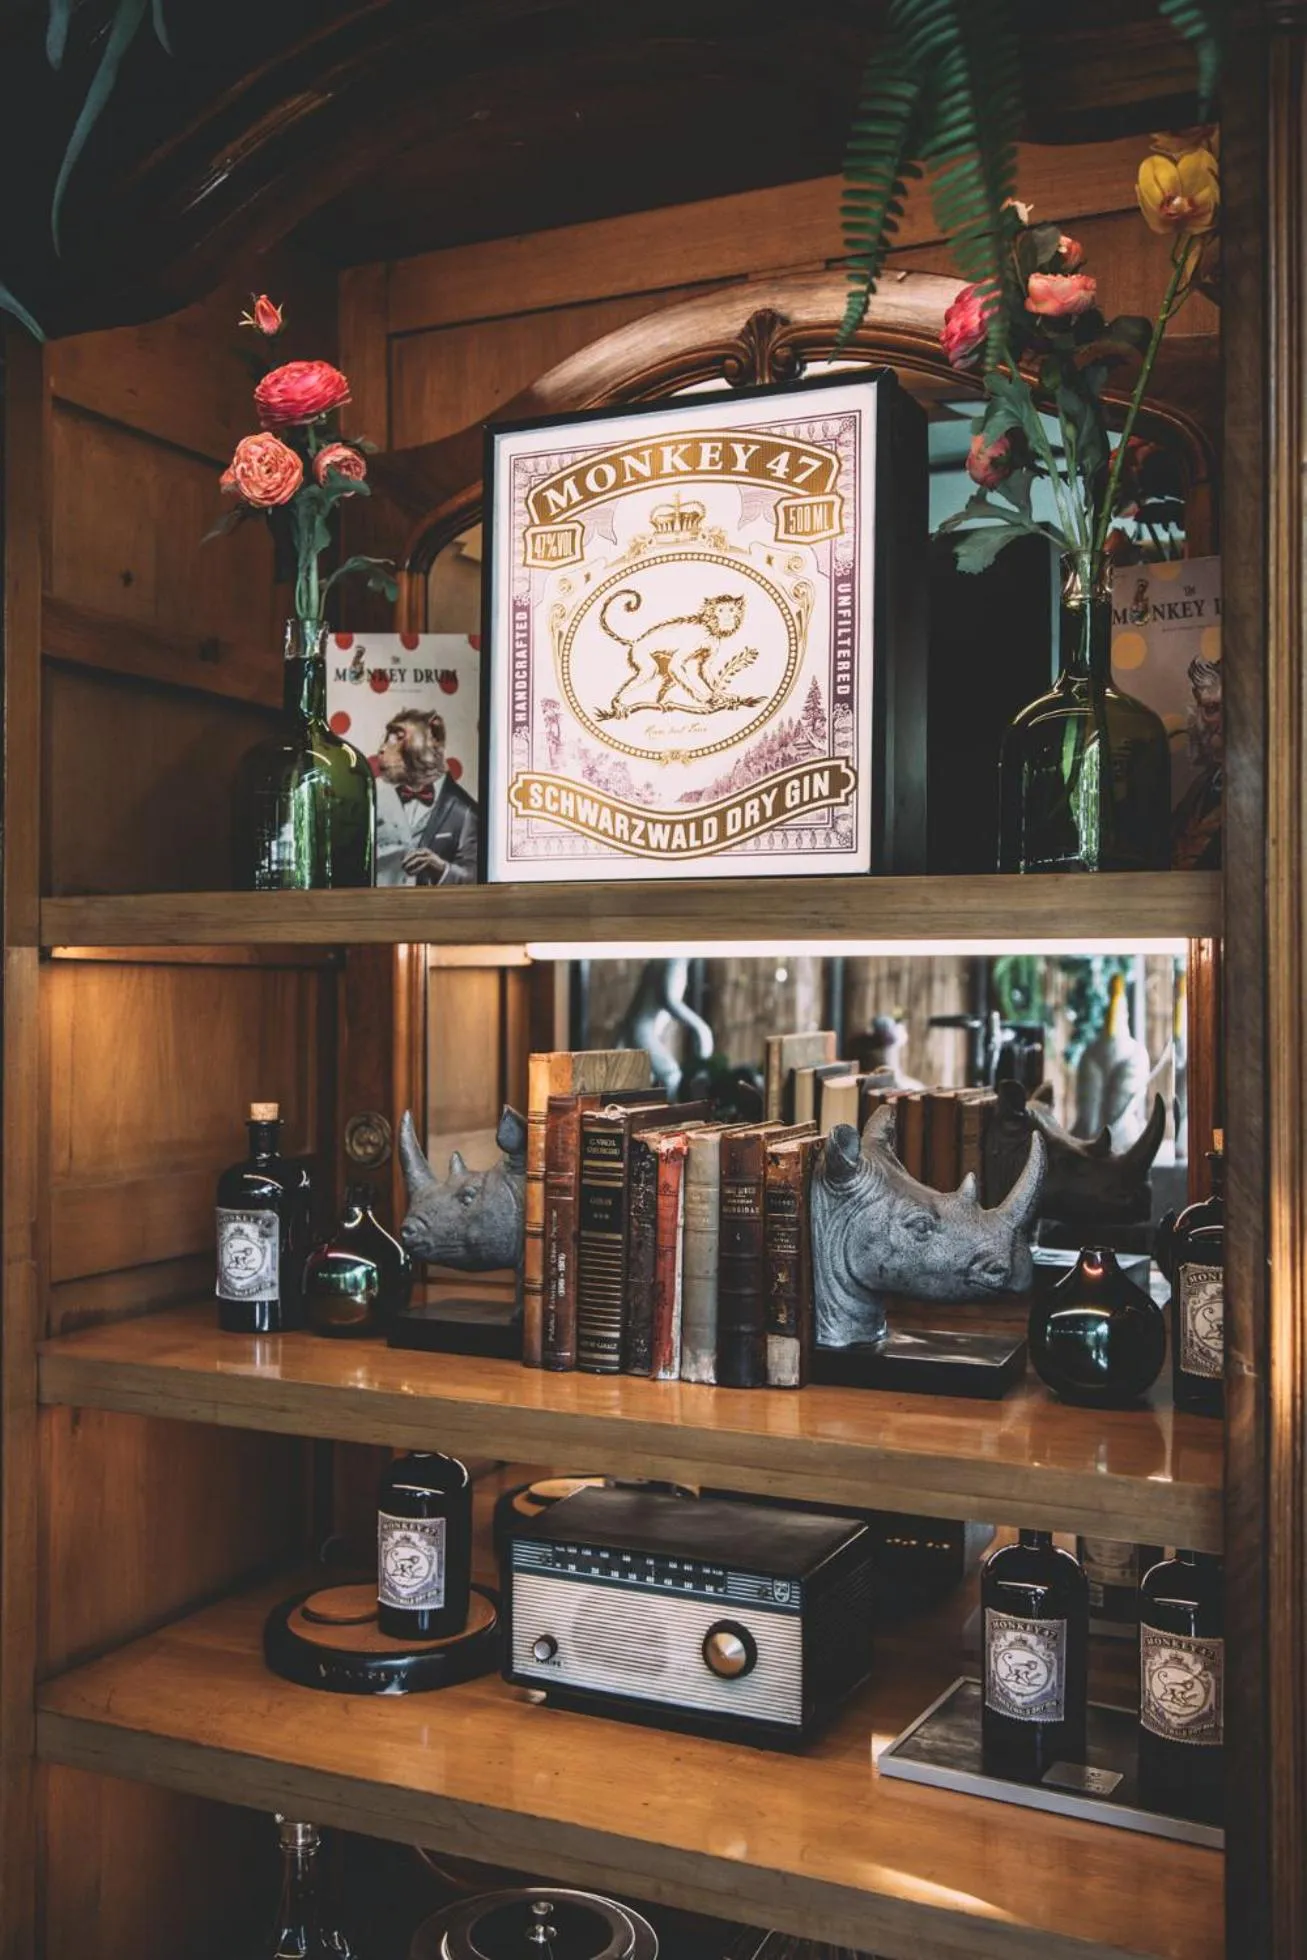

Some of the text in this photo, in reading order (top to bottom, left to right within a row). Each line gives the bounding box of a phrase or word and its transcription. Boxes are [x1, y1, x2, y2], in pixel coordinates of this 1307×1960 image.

[542, 442, 823, 516] MONKEY 47
[789, 504, 812, 533] 500
[413, 668, 458, 683] DRUM
[514, 611, 528, 722] HANDCRAFTED
[837, 583, 852, 695] UNFILTERED
[528, 770, 831, 850] SCHWARZWALD DRY GIN
